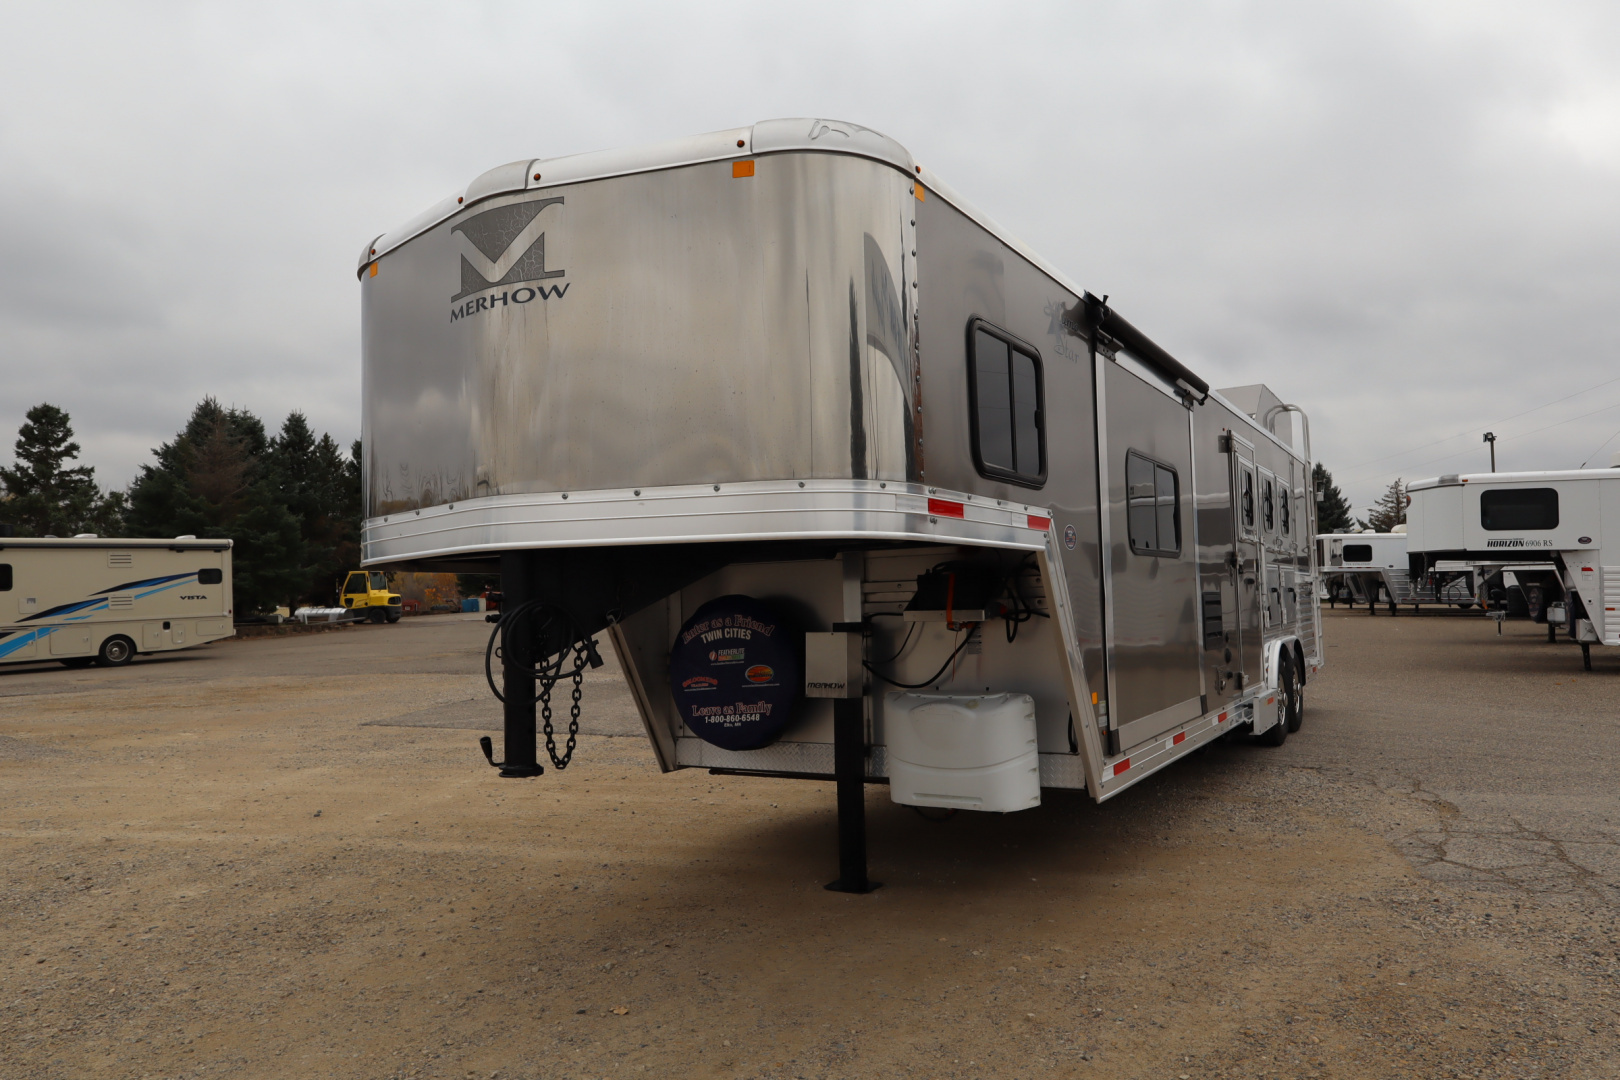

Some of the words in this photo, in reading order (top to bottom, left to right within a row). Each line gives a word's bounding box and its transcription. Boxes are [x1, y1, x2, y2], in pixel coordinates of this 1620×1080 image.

[450, 283, 570, 323] MERHOW
[1487, 540, 1525, 548] HORIZON
[1525, 540, 1542, 548] 6906
[1543, 540, 1553, 548] RS
[682, 621, 709, 645] Enter
[710, 617, 723, 628] as
[724, 617, 732, 626] a
[734, 614, 776, 637] Friend
[700, 629, 723, 644] TWIN
[724, 628, 752, 641] CITIES
[691, 705, 722, 717] Leave
[722, 705, 735, 715] as
[735, 700, 773, 716] Family
[704, 714, 760, 724] 1-800-860-6548
